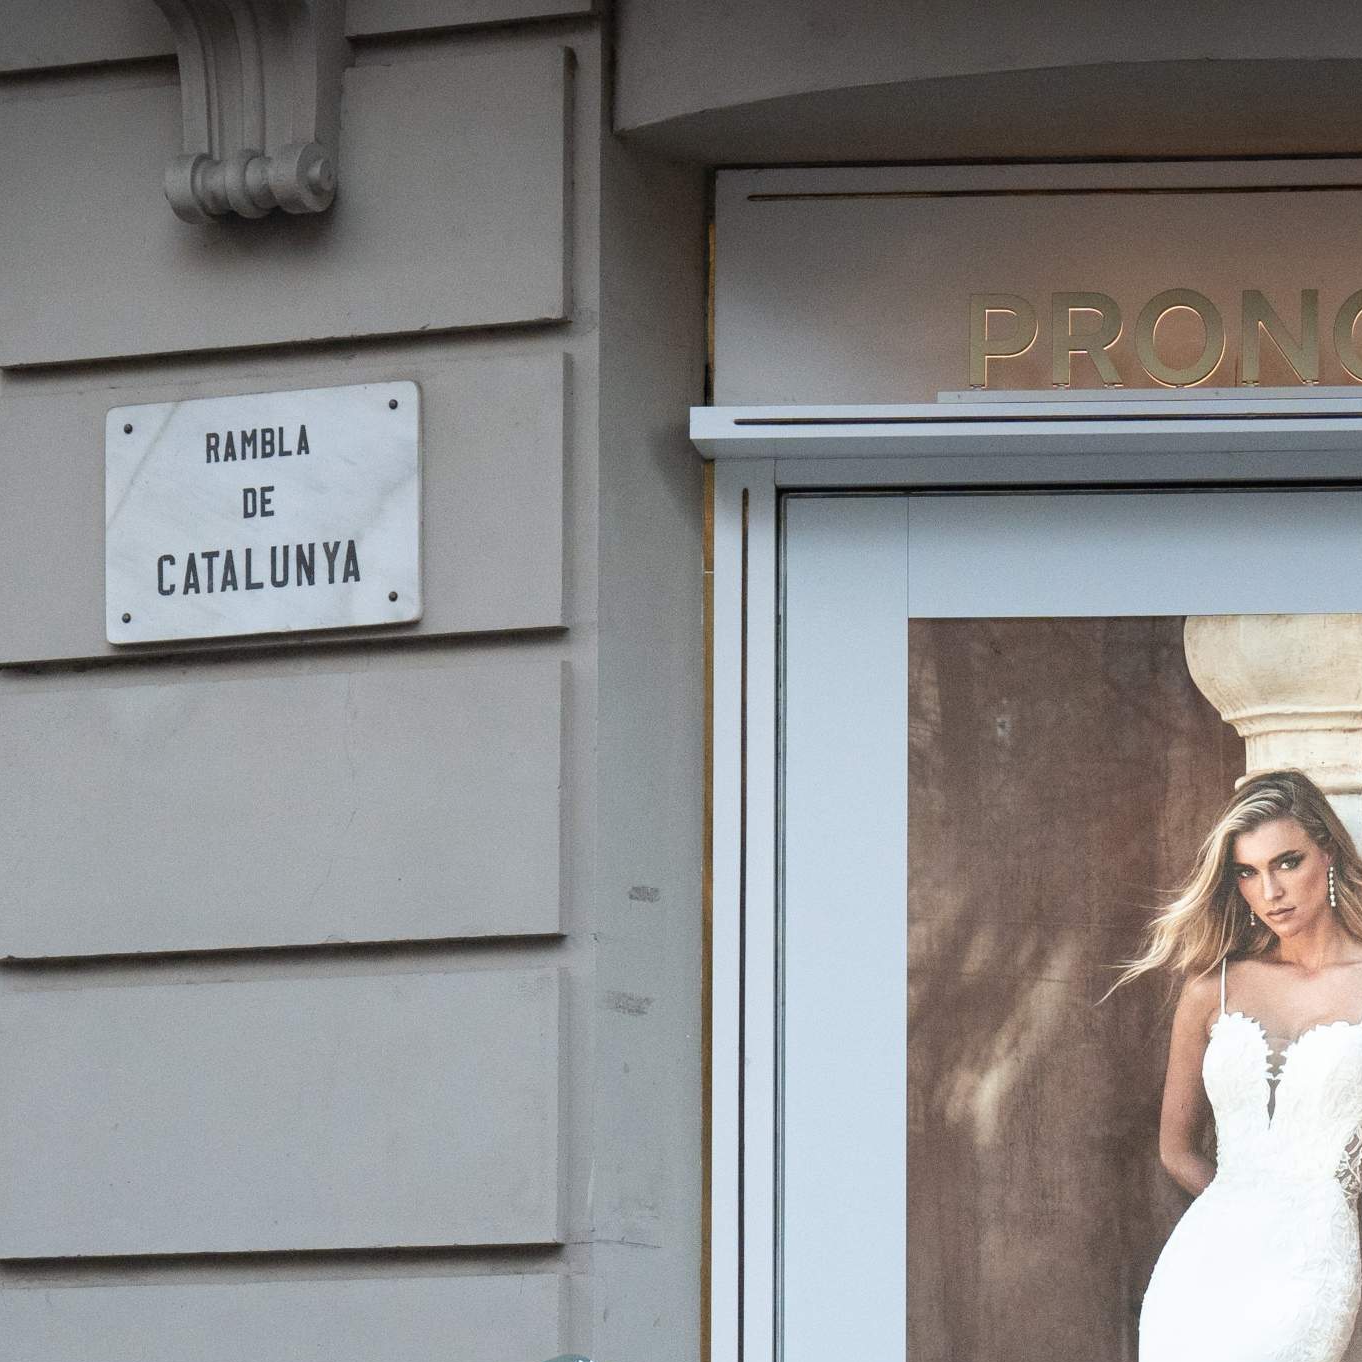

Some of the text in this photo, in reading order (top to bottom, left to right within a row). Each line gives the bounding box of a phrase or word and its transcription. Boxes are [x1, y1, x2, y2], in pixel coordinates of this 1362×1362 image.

[205, 424, 310, 464] RAMBLA
[242, 485, 275, 519] DE
[157, 539, 361, 597] CATALUNYA
